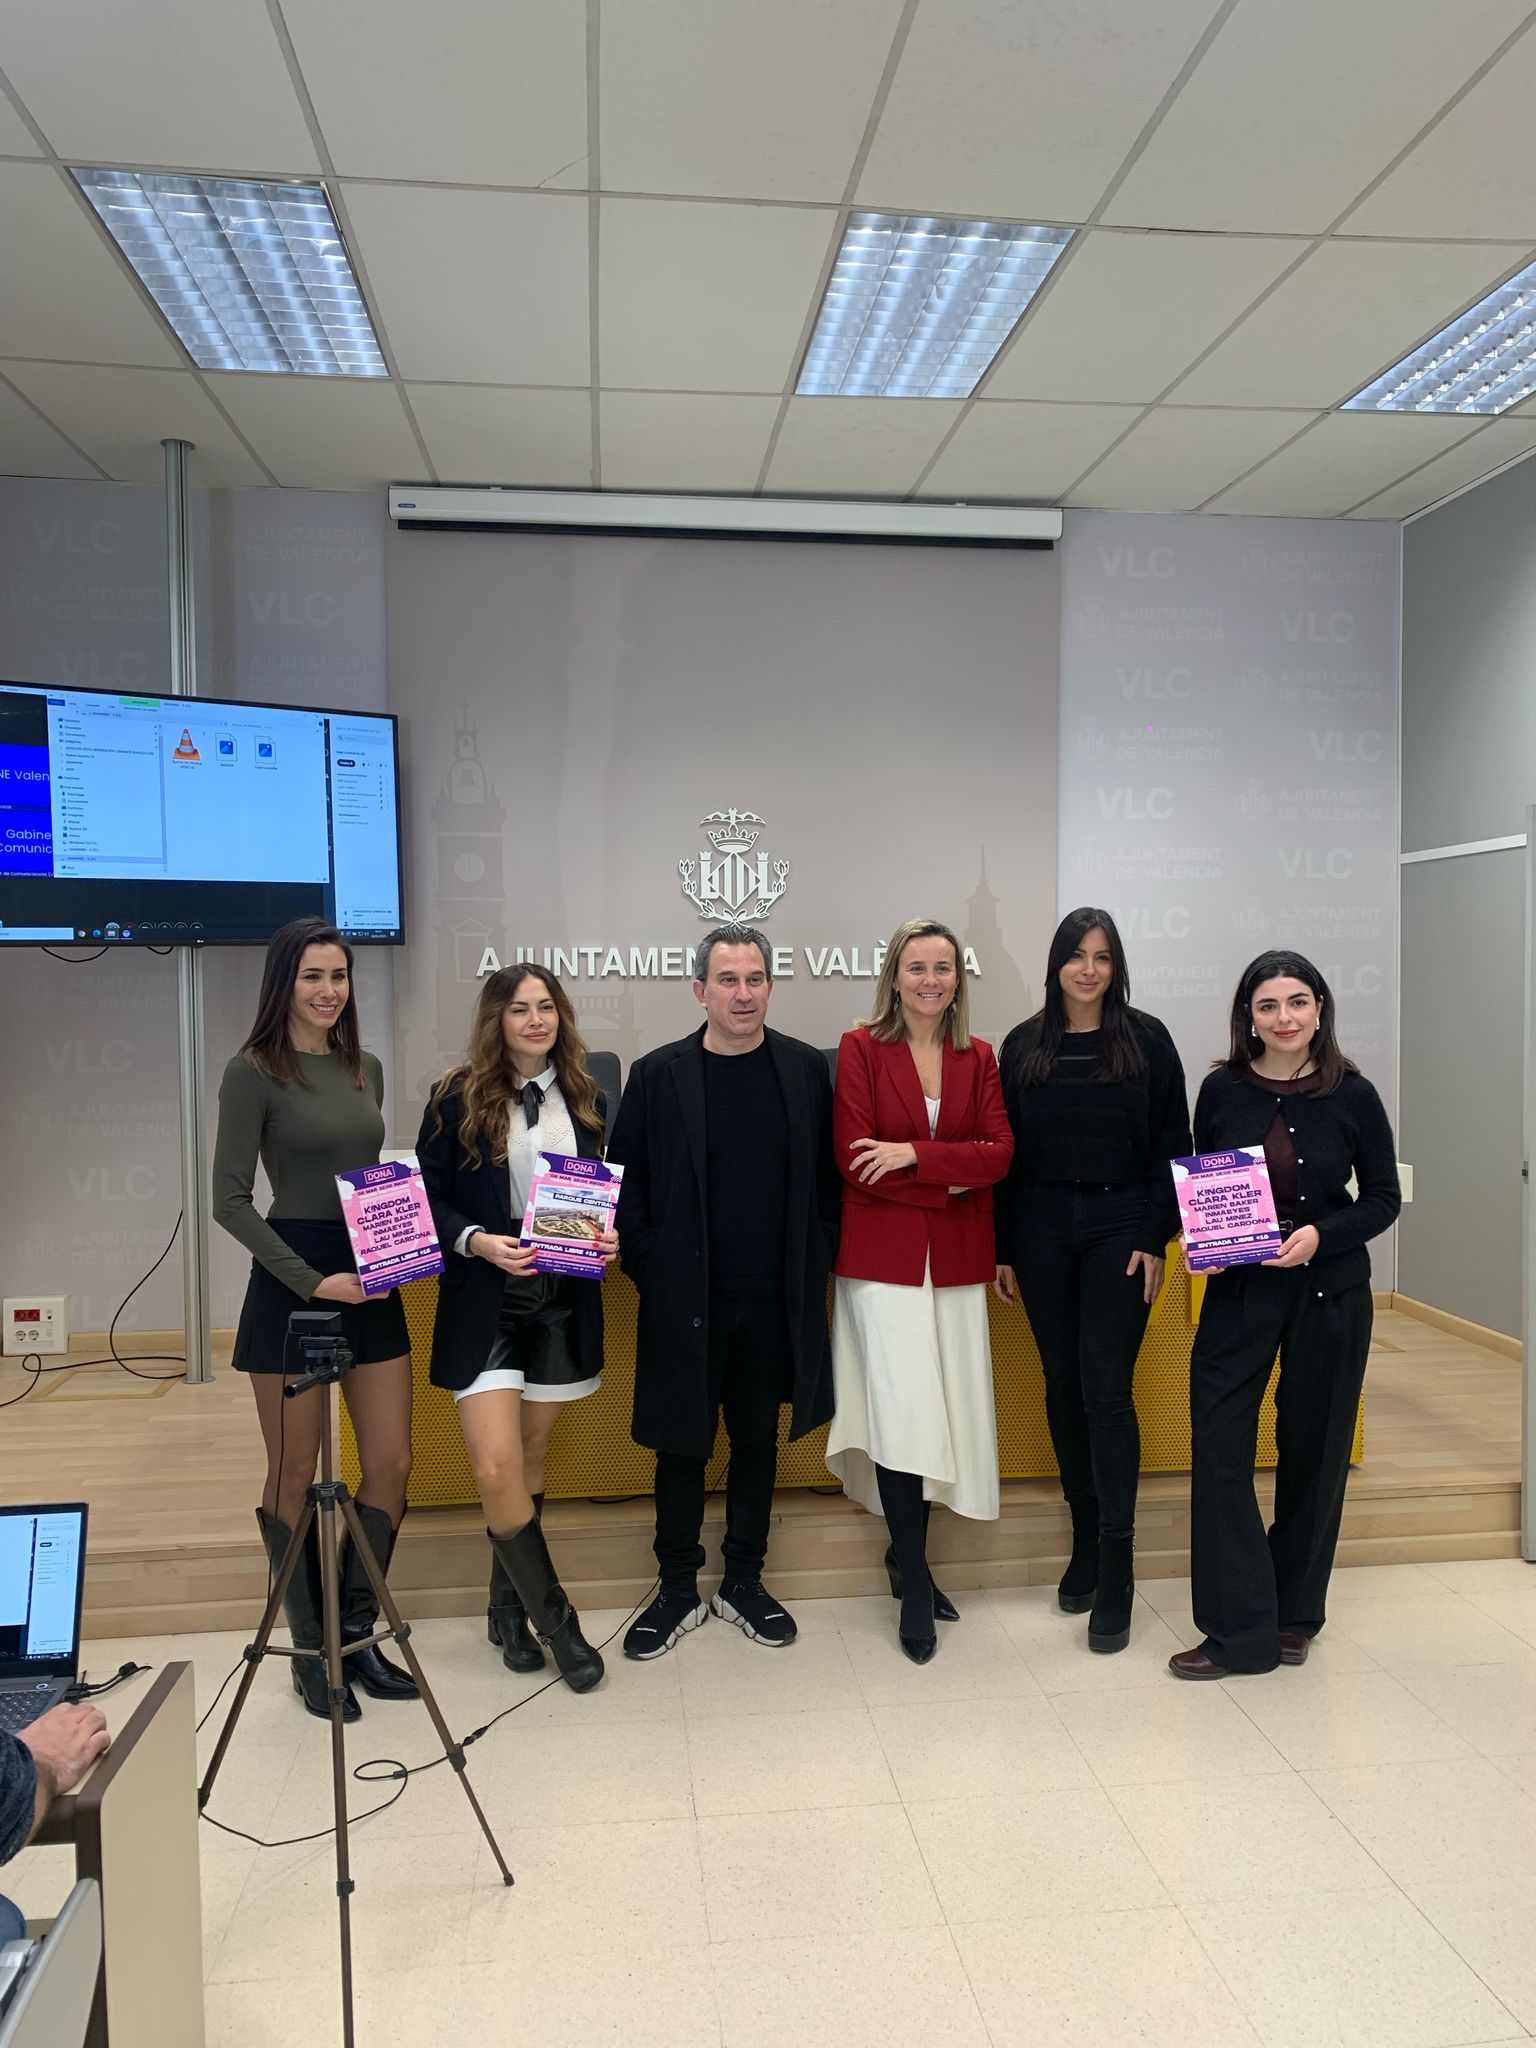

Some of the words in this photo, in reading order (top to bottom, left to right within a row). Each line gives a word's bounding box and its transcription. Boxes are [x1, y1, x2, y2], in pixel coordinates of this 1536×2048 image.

[30, 516, 124, 556] VLC
[247, 545, 271, 561] DE
[1098, 545, 1176, 579] VLC
[1280, 570, 1300, 584] DE
[56, 584, 168, 601] AJUNTAME
[248, 591, 337, 626] VLC
[1117, 625, 1138, 640] DE
[1280, 609, 1356, 643] VLC
[56, 650, 148, 687] VLC
[250, 674, 272, 690] DE
[1114, 666, 1194, 701] VLC
[1280, 688, 1300, 703] DE
[1116, 746, 1137, 760] DE
[1308, 729, 1383, 763] VLC
[1095, 786, 1177, 820] VLC
[1278, 807, 1299, 821] DE
[1114, 847, 1223, 861] AJUNTAMENT
[1278, 848, 1353, 880] VLC
[1114, 866, 1137, 880] DE
[1113, 906, 1191, 939] VLC
[1277, 924, 1299, 938] DE
[477, 947, 701, 977] AJUNTAME
[773, 948, 795, 976] E
[804, 939, 982, 977] VALÈA
[65, 976, 177, 990] AJUNTAMEN
[41, 1038, 134, 1073] VLC
[67, 1103, 180, 1120] AJUNTAMEN
[98, 1120, 180, 1137] VALÈNCI
[567, 1162, 593, 1173] DONA
[1203, 1156, 1233, 1167] DONA
[367, 1168, 393, 1182] DONA
[66, 1166, 160, 1201] VLC
[366, 1187, 378, 1195] MAR
[555, 1193, 582, 1203] PARQUE
[583, 1198, 614, 1208] CENTRAL
[1188, 1195, 1228, 1206] CLARA
[1232, 1189, 1262, 1200] KLER
[1194, 1203, 1227, 1212] MARIEN
[1230, 1198, 1258, 1208] BAKER
[357, 1211, 392, 1225] CLARA
[396, 1202, 421, 1215] KLER
[1205, 1207, 1250, 1217] INMAEYES
[1205, 1217, 1223, 1225] LAU
[1225, 1213, 1252, 1222] MINEZ
[363, 1219, 392, 1231] MARIEN
[394, 1212, 419, 1223] BAKER
[373, 1221, 413, 1236] INMAEYES
[1189, 1225, 1225, 1234] RAQUEL
[1227, 1217, 1271, 1228] CARDONA
[71, 1230, 182, 1247] AJUNTAMEN
[375, 1235, 390, 1243] LAU
[392, 1227, 415, 1239] MINEZ
[1197, 1239, 1232, 1249] ENTRADA
[1234, 1236, 1254, 1244] LIBRE
[360, 1243, 392, 1256] RAQUEL
[394, 1231, 431, 1246] CARDONA
[530, 1242, 563, 1252] ENTRADA
[369, 1257, 400, 1271] ENTRADA
[401, 1251, 419, 1262] LIBRE
